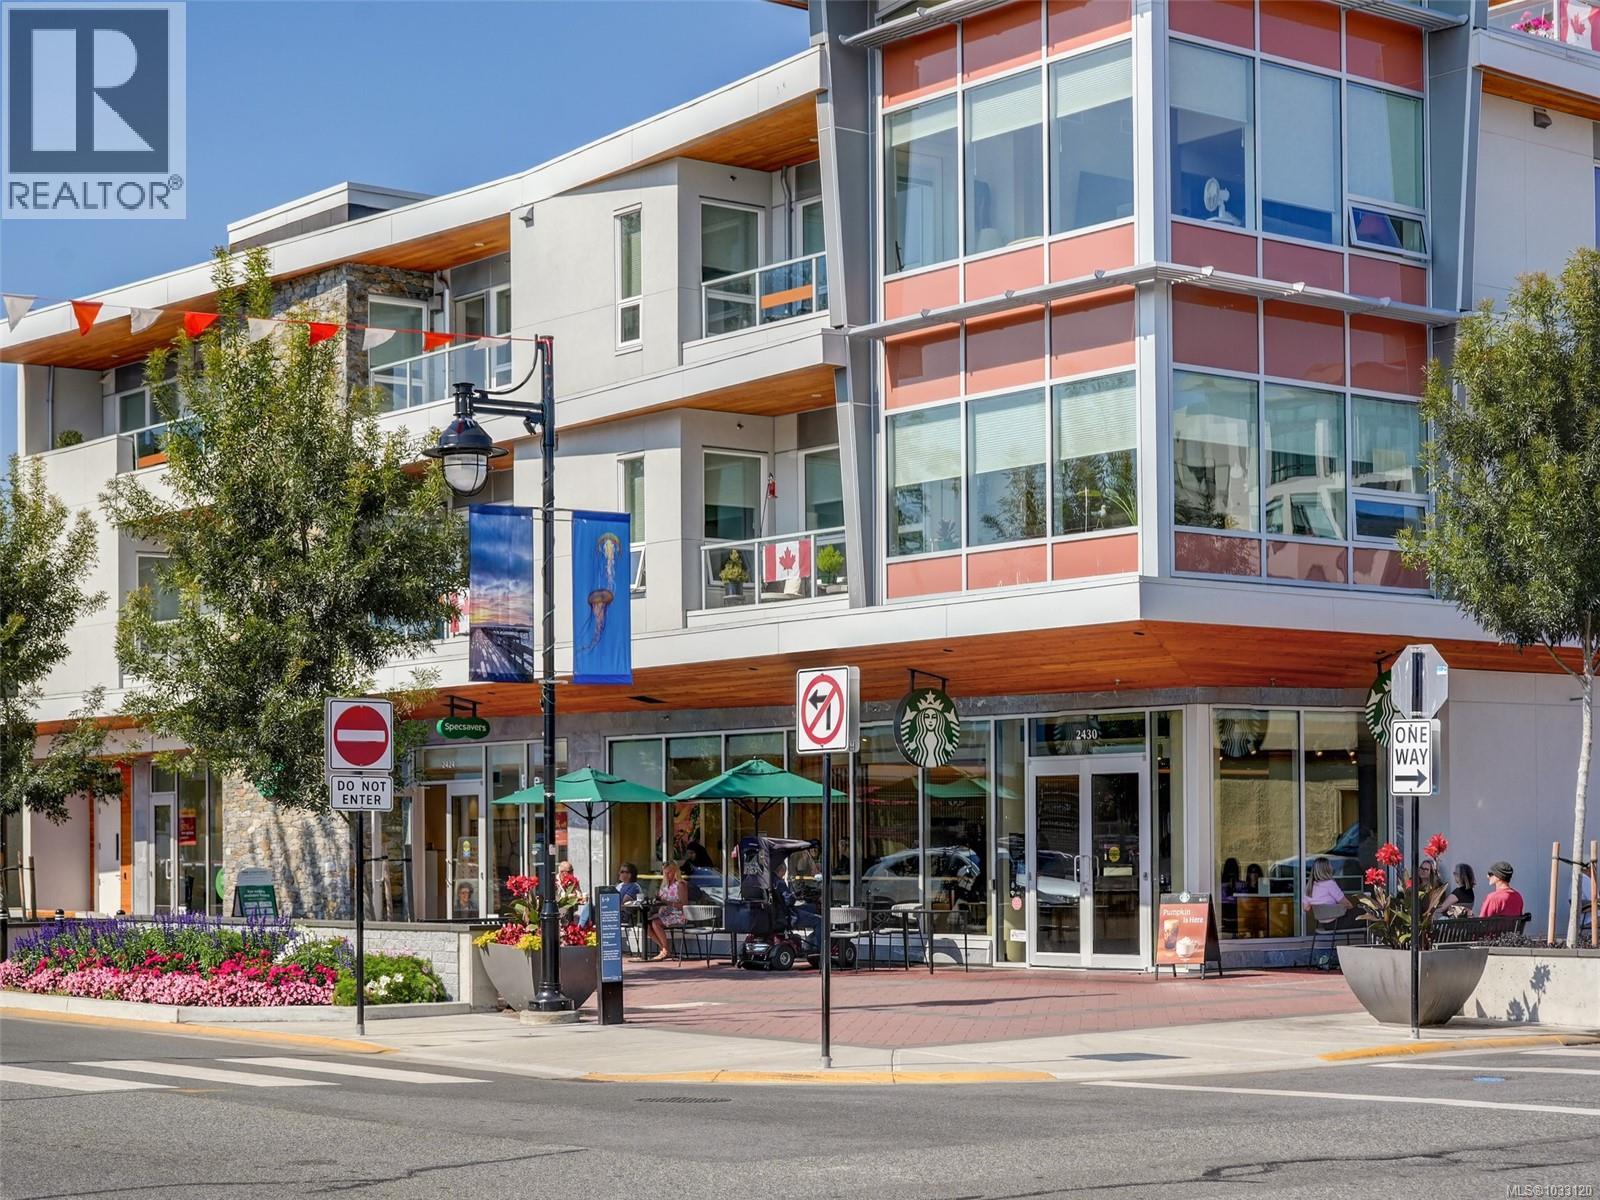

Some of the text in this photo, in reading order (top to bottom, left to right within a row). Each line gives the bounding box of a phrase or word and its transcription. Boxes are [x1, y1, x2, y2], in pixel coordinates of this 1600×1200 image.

[444, 722, 487, 732] Specsavers
[1075, 728, 1098, 740] 2430
[1395, 726, 1428, 744] ONE
[1395, 748, 1428, 765] WAY
[337, 780, 387, 792] DO NOT
[342, 794, 381, 805] ENTER
